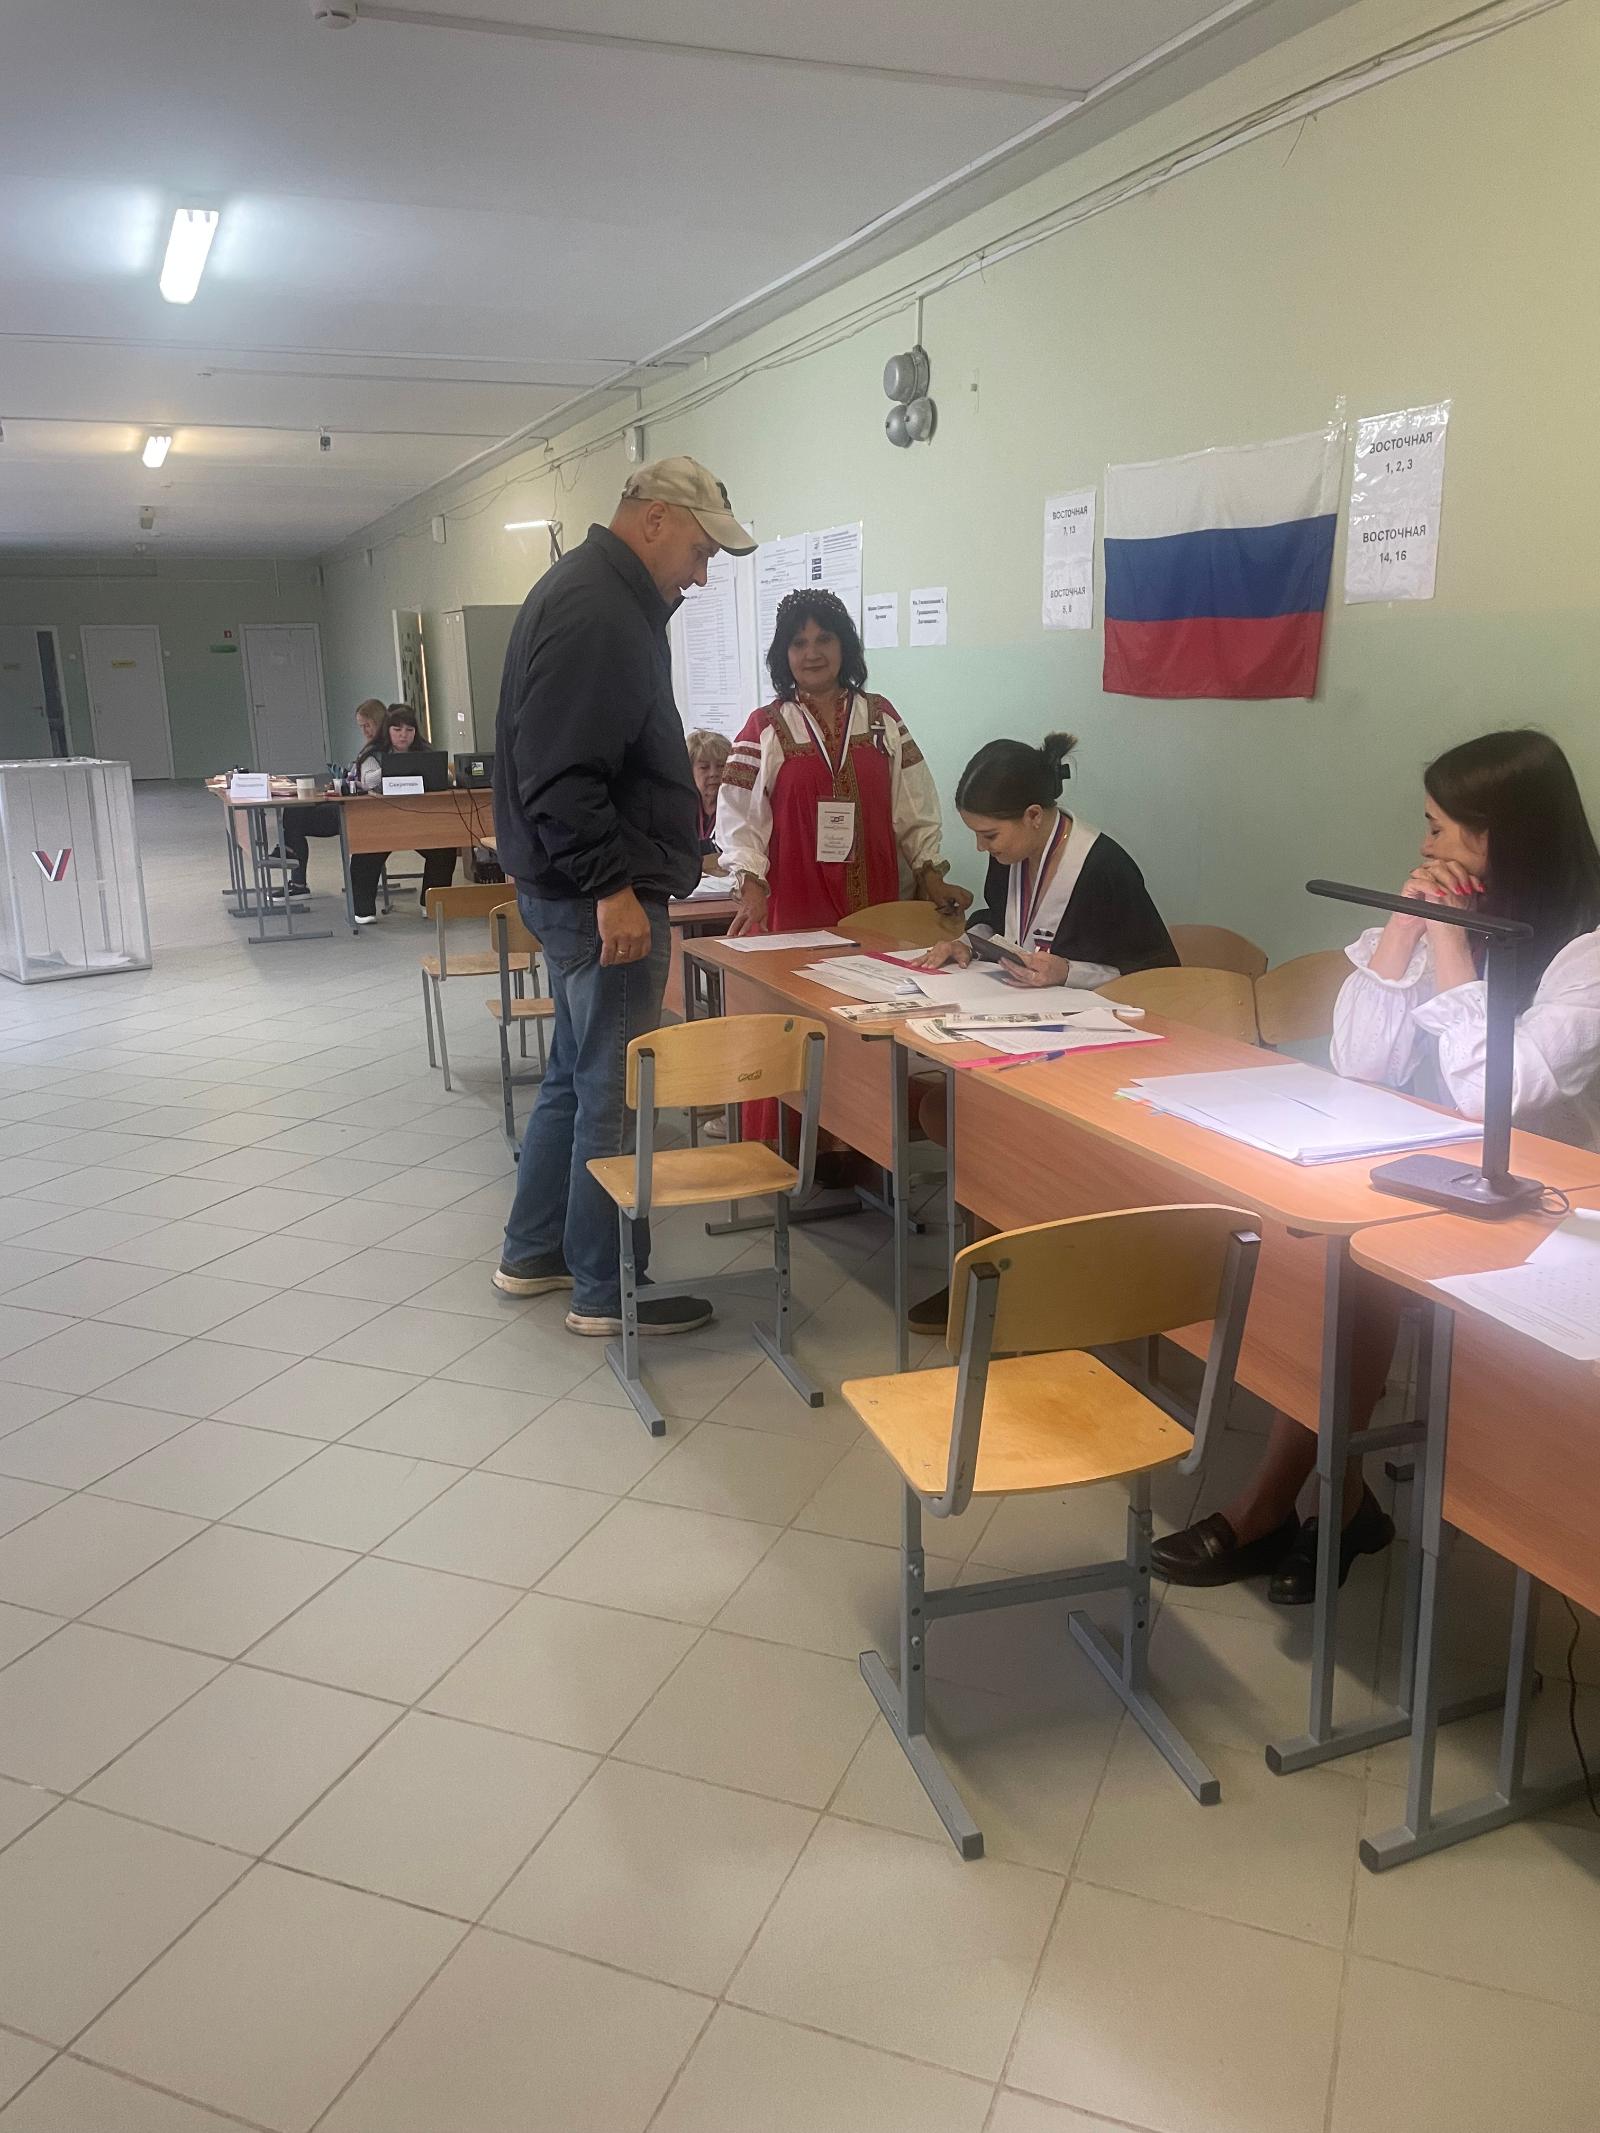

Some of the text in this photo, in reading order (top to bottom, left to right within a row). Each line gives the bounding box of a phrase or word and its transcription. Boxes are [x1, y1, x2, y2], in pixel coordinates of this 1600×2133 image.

[1370, 431, 1433, 454] ВОСТОЧНАЯ
[1385, 458, 1413, 475] 1, 2, 3
[1052, 505, 1088, 520] ВОСТОЧНАЯ
[1362, 524, 1426, 543] ВОСТОЧНАЯ
[1380, 550, 1407, 565] 14, 16
[1050, 586, 1086, 599] ВОСТОЧНАЯ
